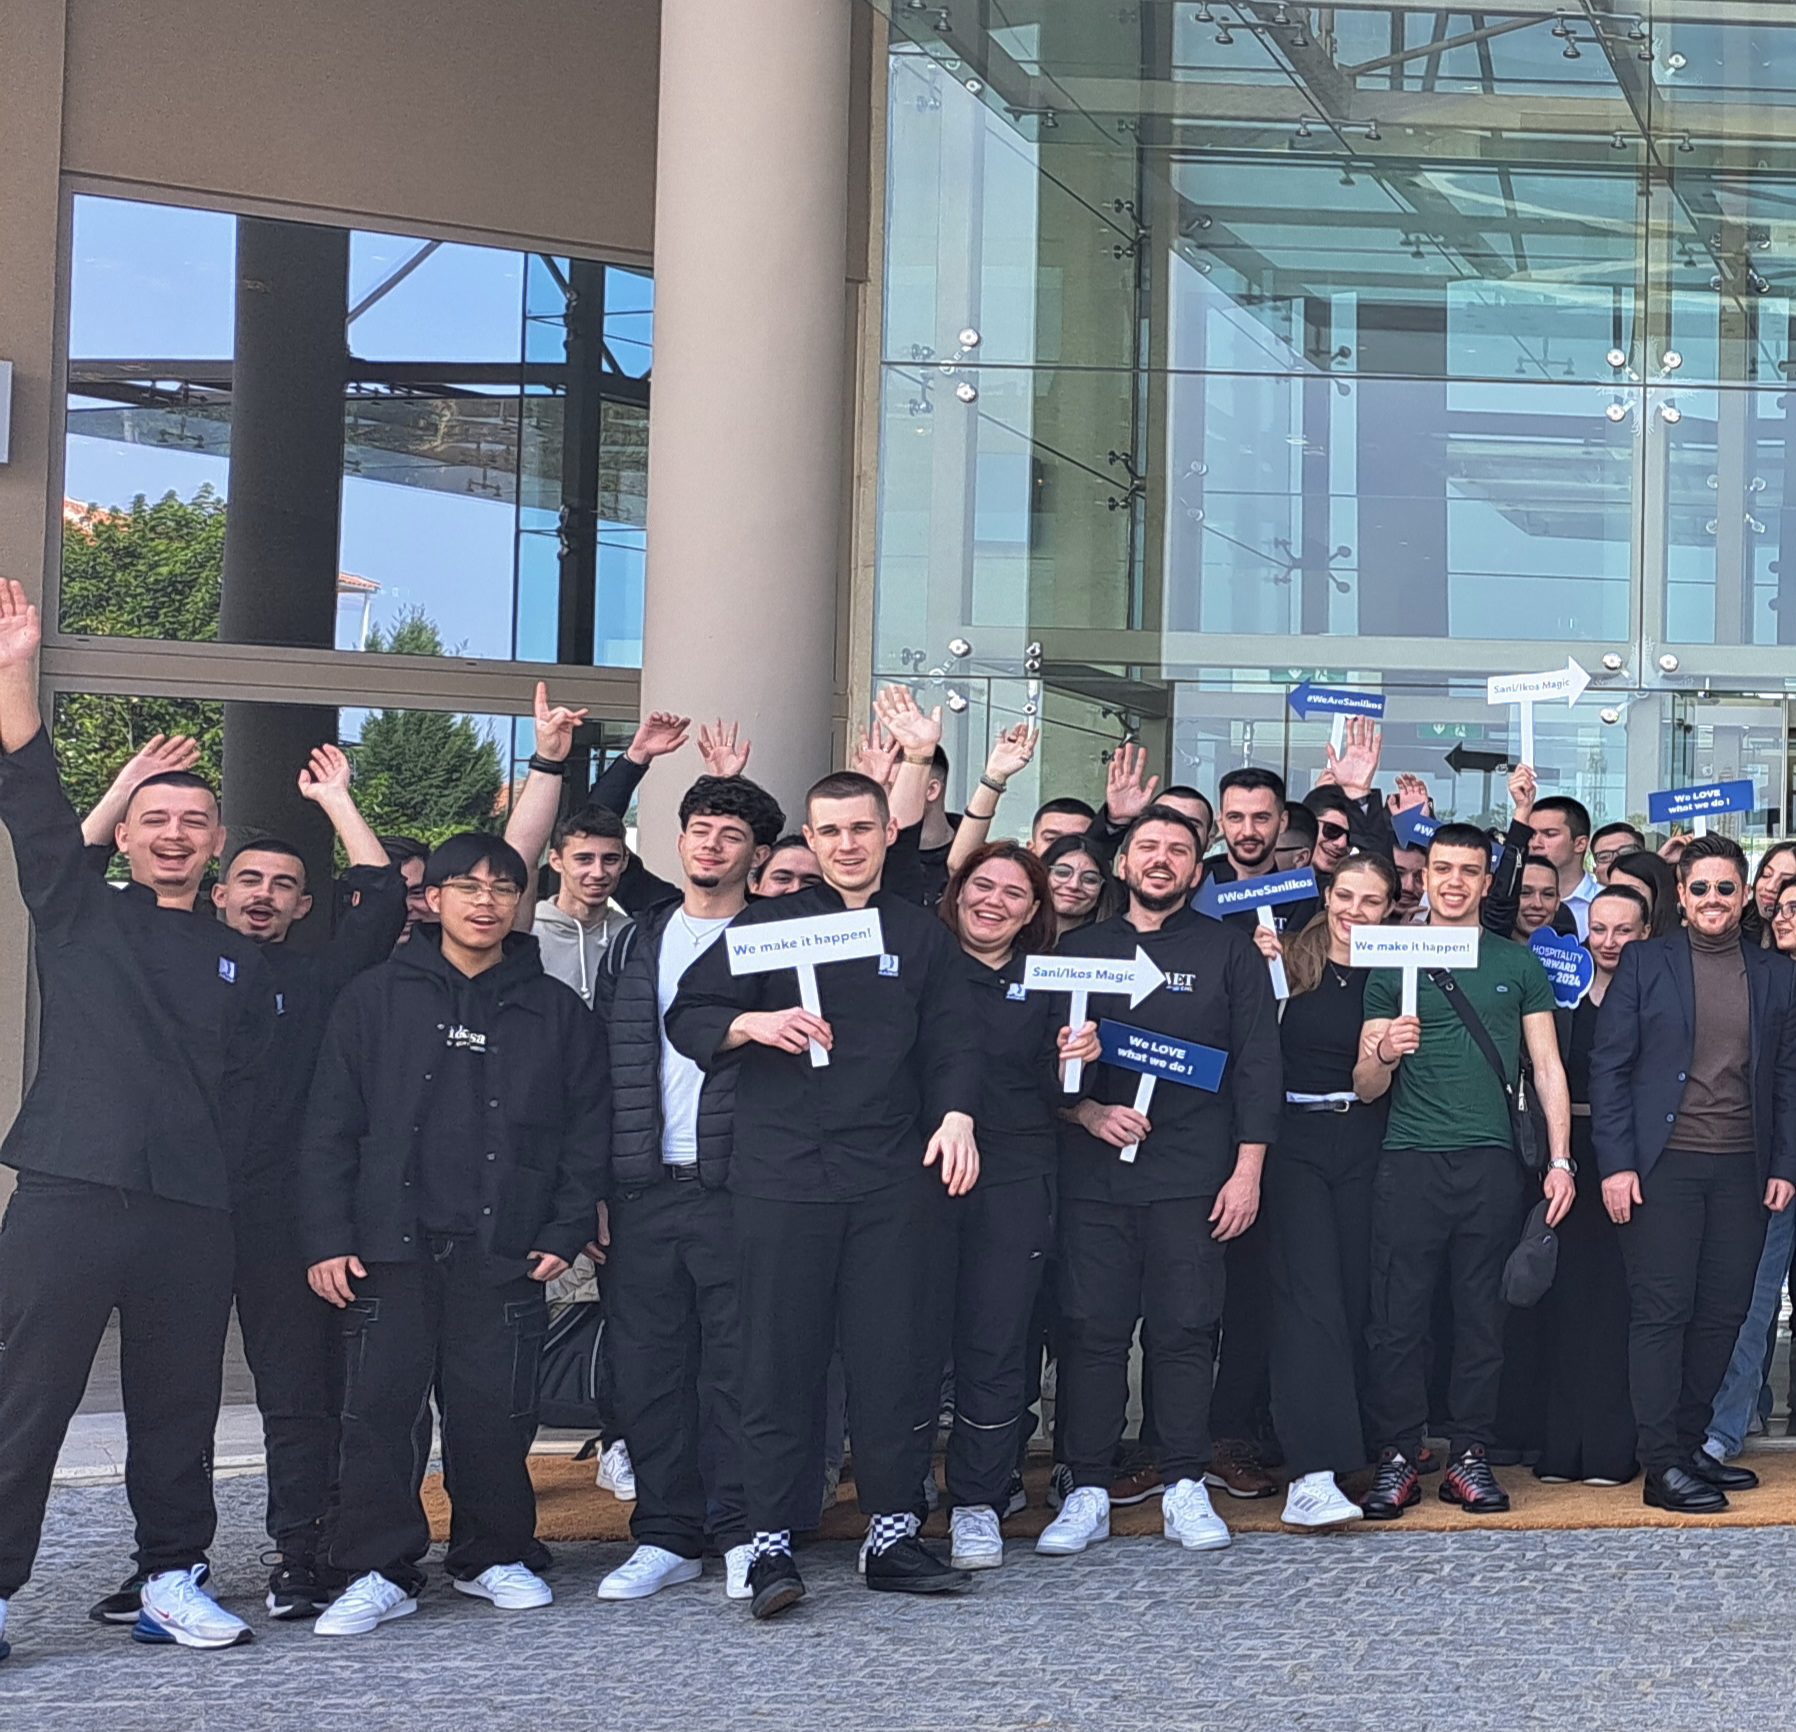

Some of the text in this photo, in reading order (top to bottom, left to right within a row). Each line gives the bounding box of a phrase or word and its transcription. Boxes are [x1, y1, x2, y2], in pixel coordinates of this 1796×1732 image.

[1542, 678, 1570, 690] Magic
[1674, 789, 1721, 804] We LOVE
[1668, 803, 1693, 814] what
[1694, 801, 1709, 810] we
[1711, 798, 1724, 808] do
[733, 928, 872, 956] We make it happen!
[1355, 941, 1470, 954] We make it happen!
[1532, 944, 1584, 963] HOSPITALITY
[1095, 969, 1135, 983] Magic
[1555, 971, 1581, 988] 2024
[1129, 1035, 1187, 1059] We LOVE
[1117, 1047, 1147, 1063] what
[1149, 1055, 1166, 1068] we
[1169, 1060, 1185, 1074] do
